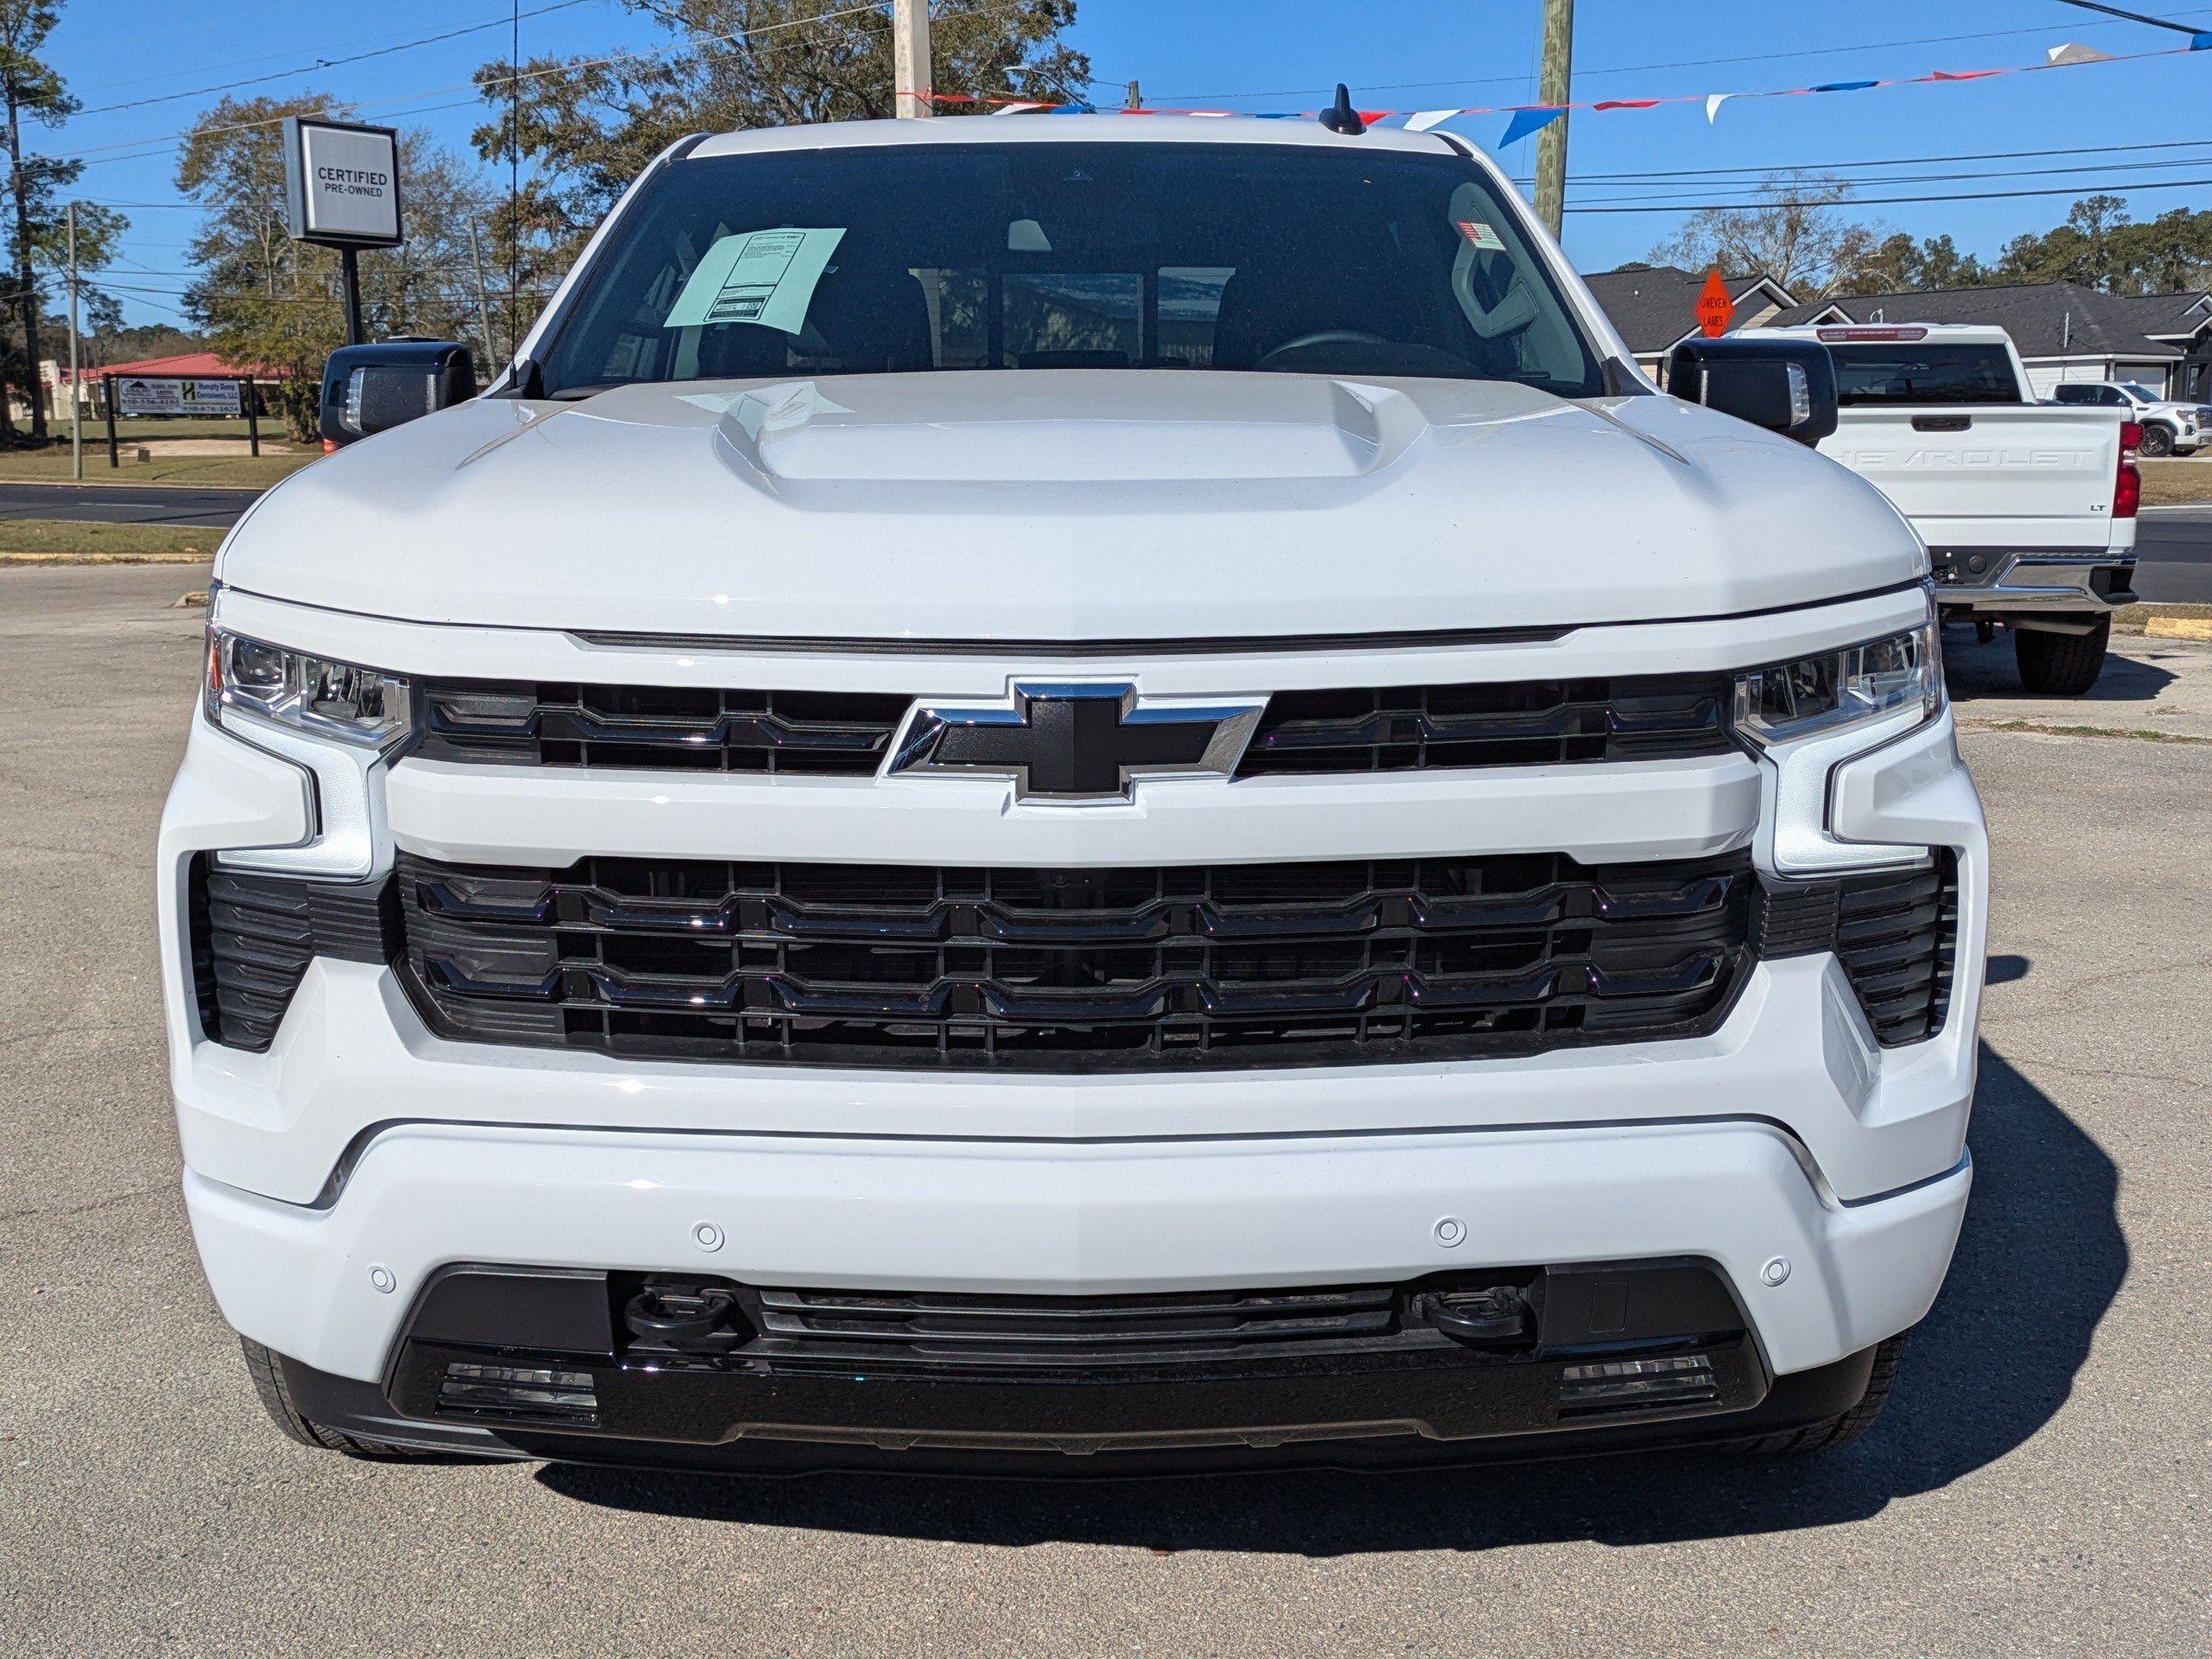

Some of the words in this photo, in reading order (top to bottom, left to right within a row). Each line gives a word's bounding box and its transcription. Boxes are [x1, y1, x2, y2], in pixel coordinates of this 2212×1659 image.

[318, 167, 388, 186] CERTIFIED
[324, 183, 383, 197] PRE-OWNED
[1702, 297, 1726, 309] UNEVEN
[1703, 315, 1724, 327] LANES
[1827, 449, 2094, 467] HEVROLET
